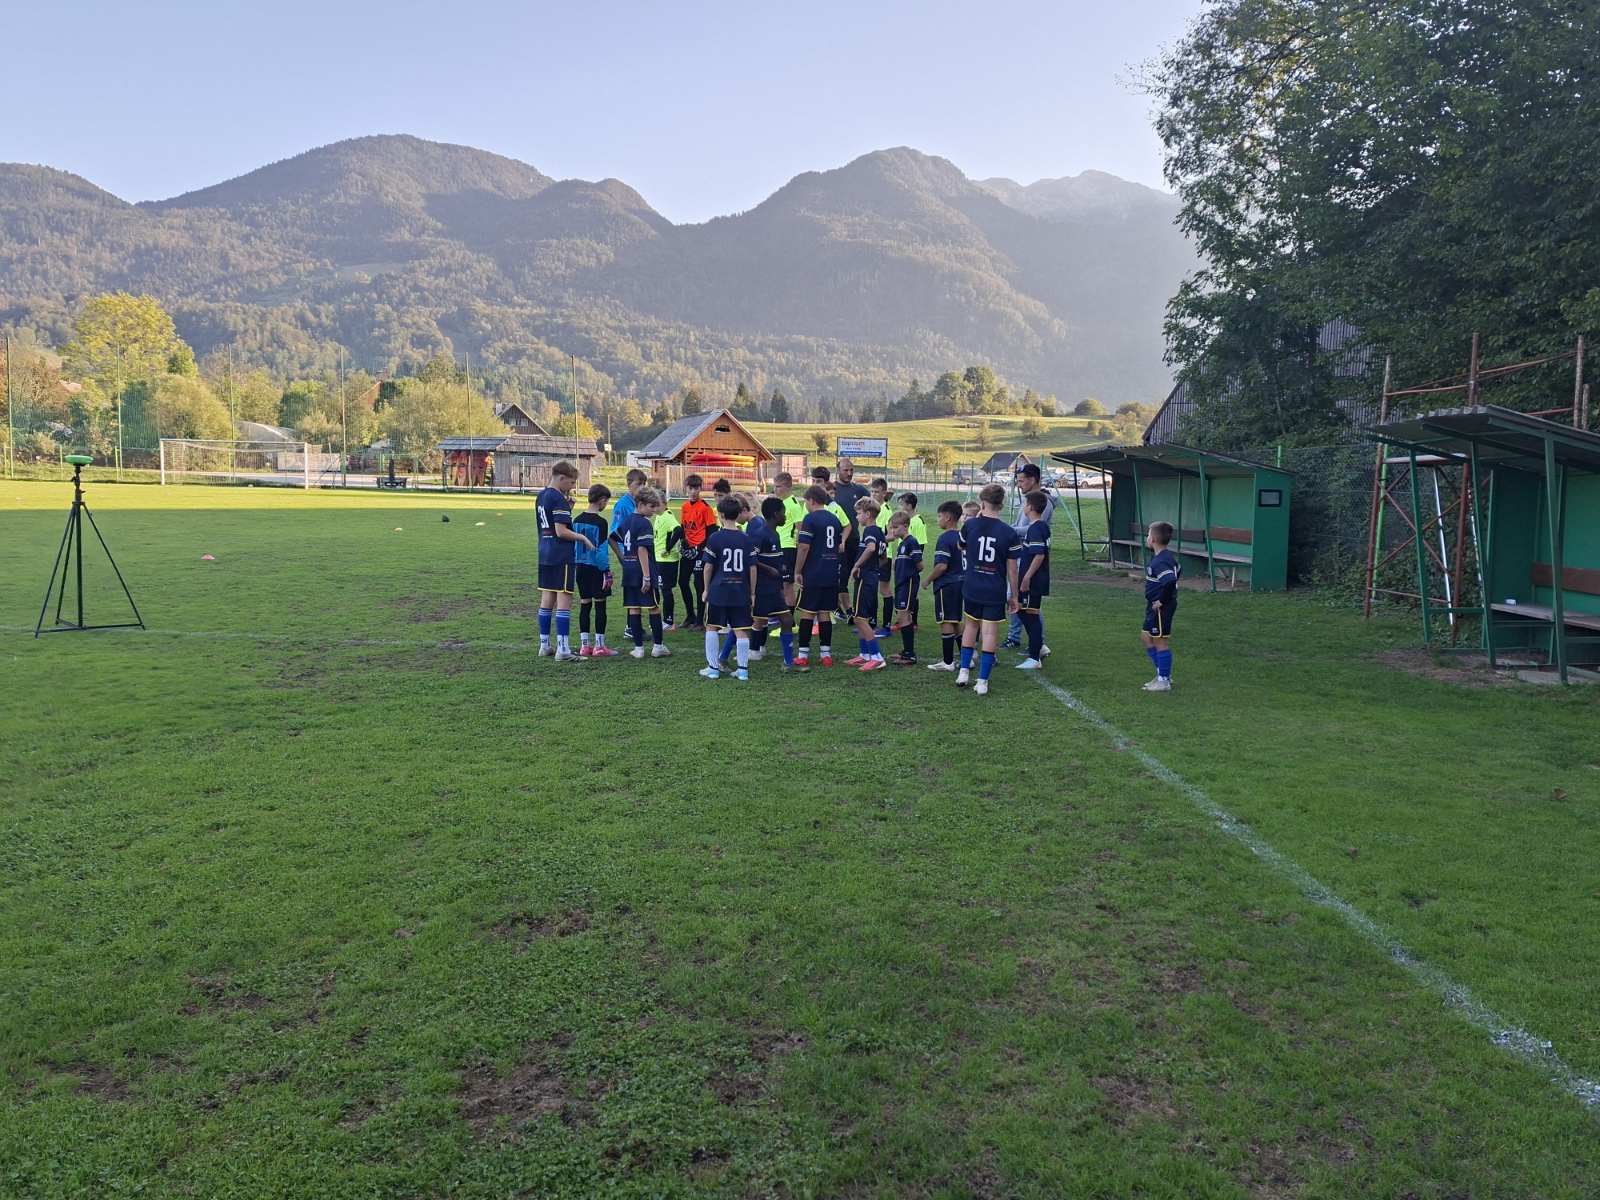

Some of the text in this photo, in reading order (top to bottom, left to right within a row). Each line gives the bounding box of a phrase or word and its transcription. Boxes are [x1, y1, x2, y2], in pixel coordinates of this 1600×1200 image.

[624, 529, 632, 551] 4
[826, 525, 835, 549] 8
[723, 548, 744, 572] 20
[978, 536, 996, 563] 15
